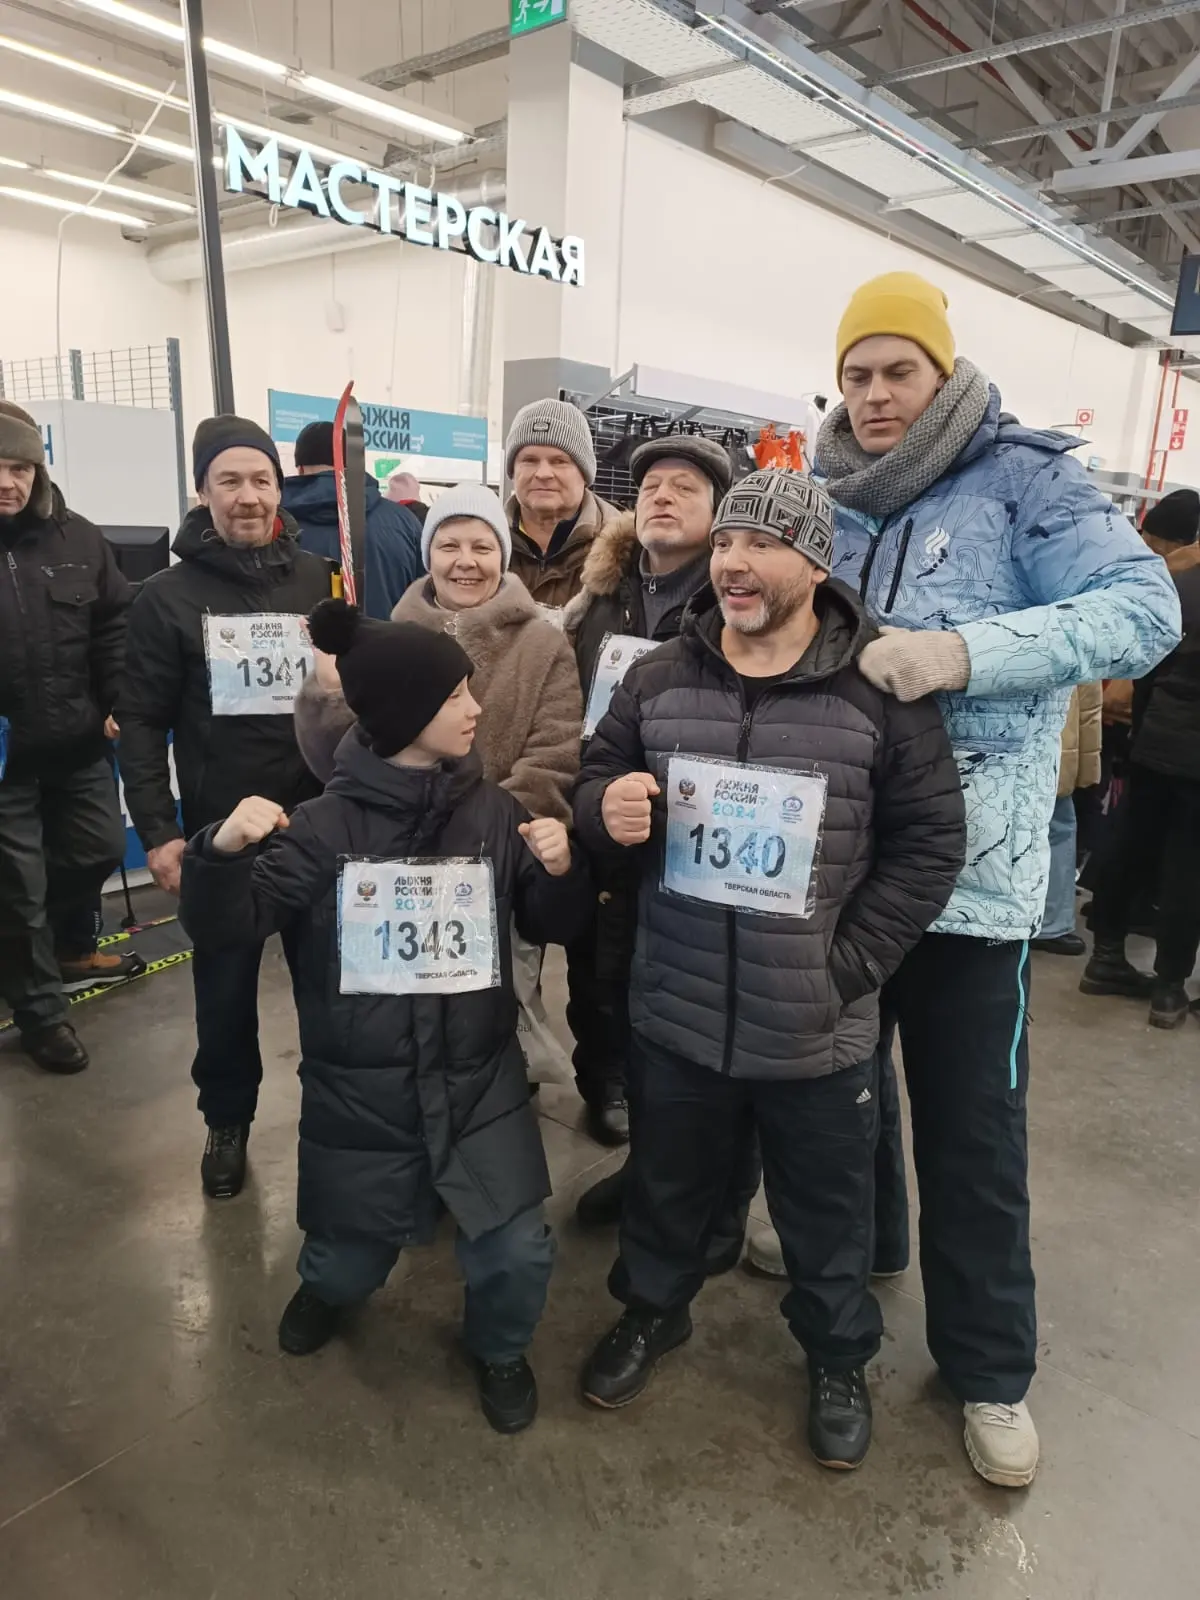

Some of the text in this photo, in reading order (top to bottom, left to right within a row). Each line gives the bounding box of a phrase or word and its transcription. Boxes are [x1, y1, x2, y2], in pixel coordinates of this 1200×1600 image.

[225, 125, 585, 287] МАСТЕРСКАЯ
[360, 406, 411, 431] ЫЖНЯ
[363, 428, 411, 451] ОССИИ
[236, 656, 308, 688] 1341
[689, 822, 787, 879] 1340
[724, 881, 793, 900] ТВЕРСКАЯ ОБЛАСТЬ
[374, 919, 468, 962] 1343
